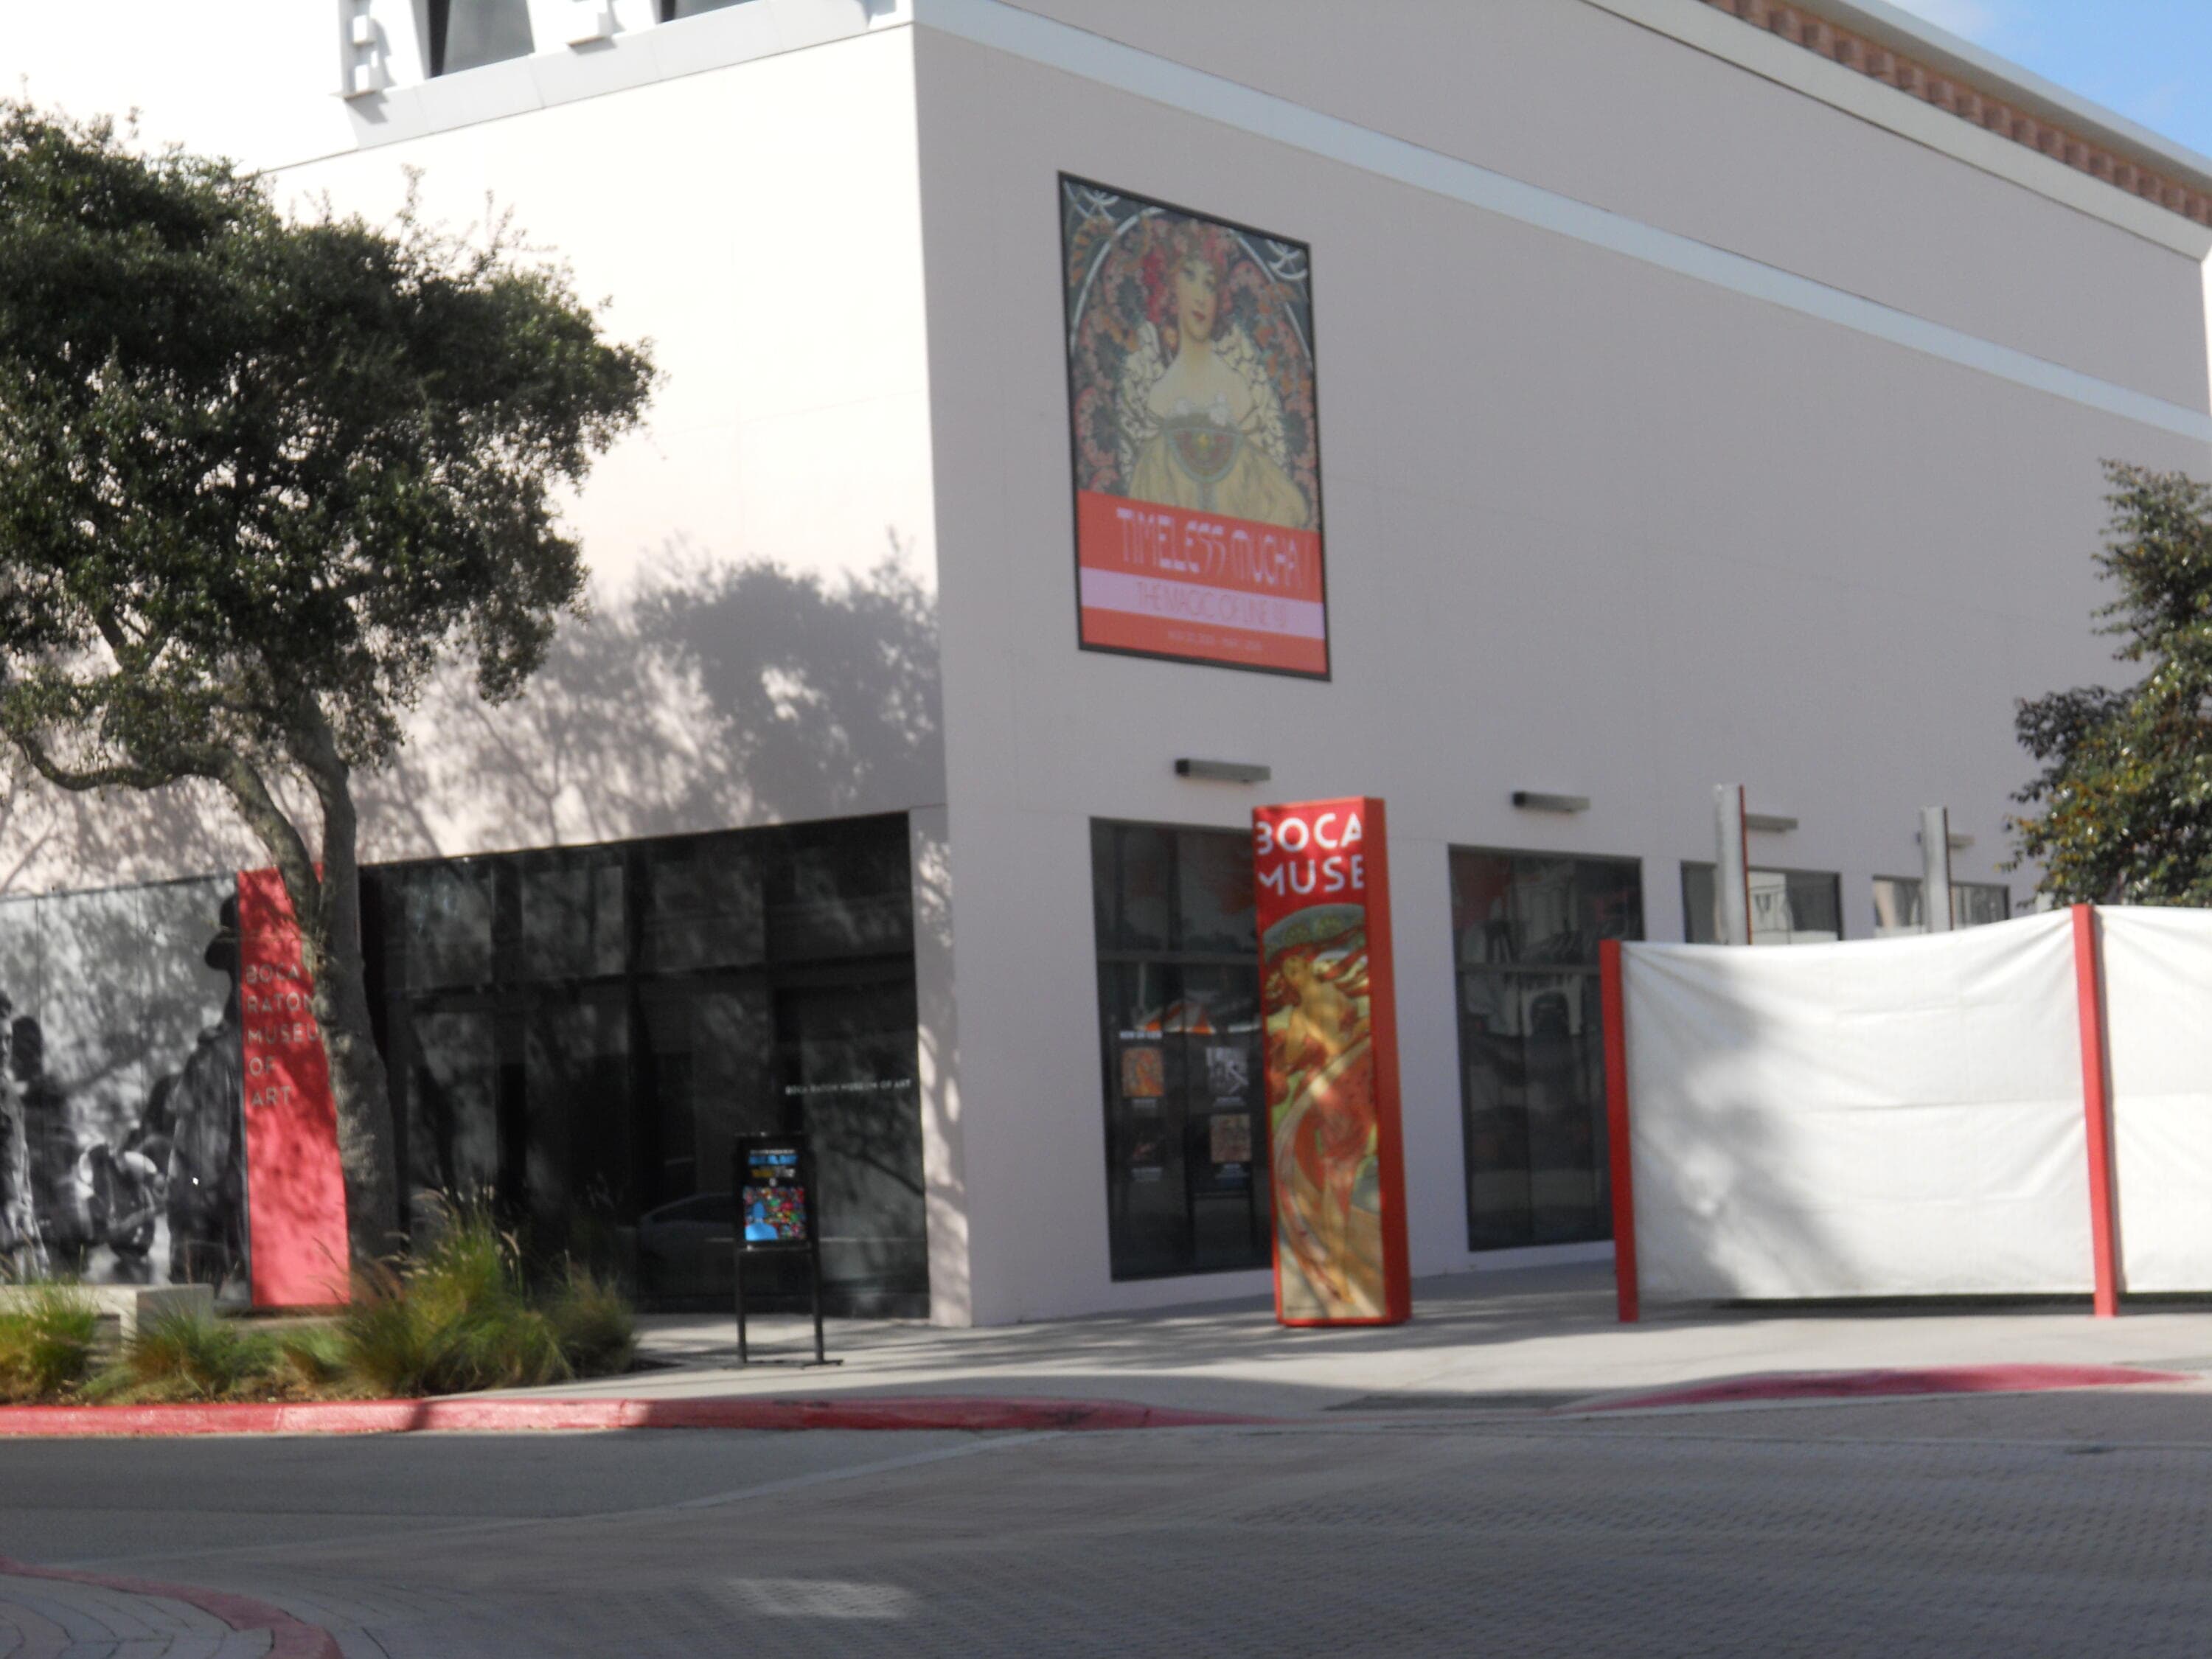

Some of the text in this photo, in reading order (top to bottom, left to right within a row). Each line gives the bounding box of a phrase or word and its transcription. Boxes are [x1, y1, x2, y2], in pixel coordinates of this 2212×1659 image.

[1256, 813, 1362, 855] BOCA
[246, 963, 301, 984] BOCA
[248, 1022, 319, 1045] MUSEU
[248, 1056, 275, 1077] OF
[252, 1085, 292, 1107] ART
